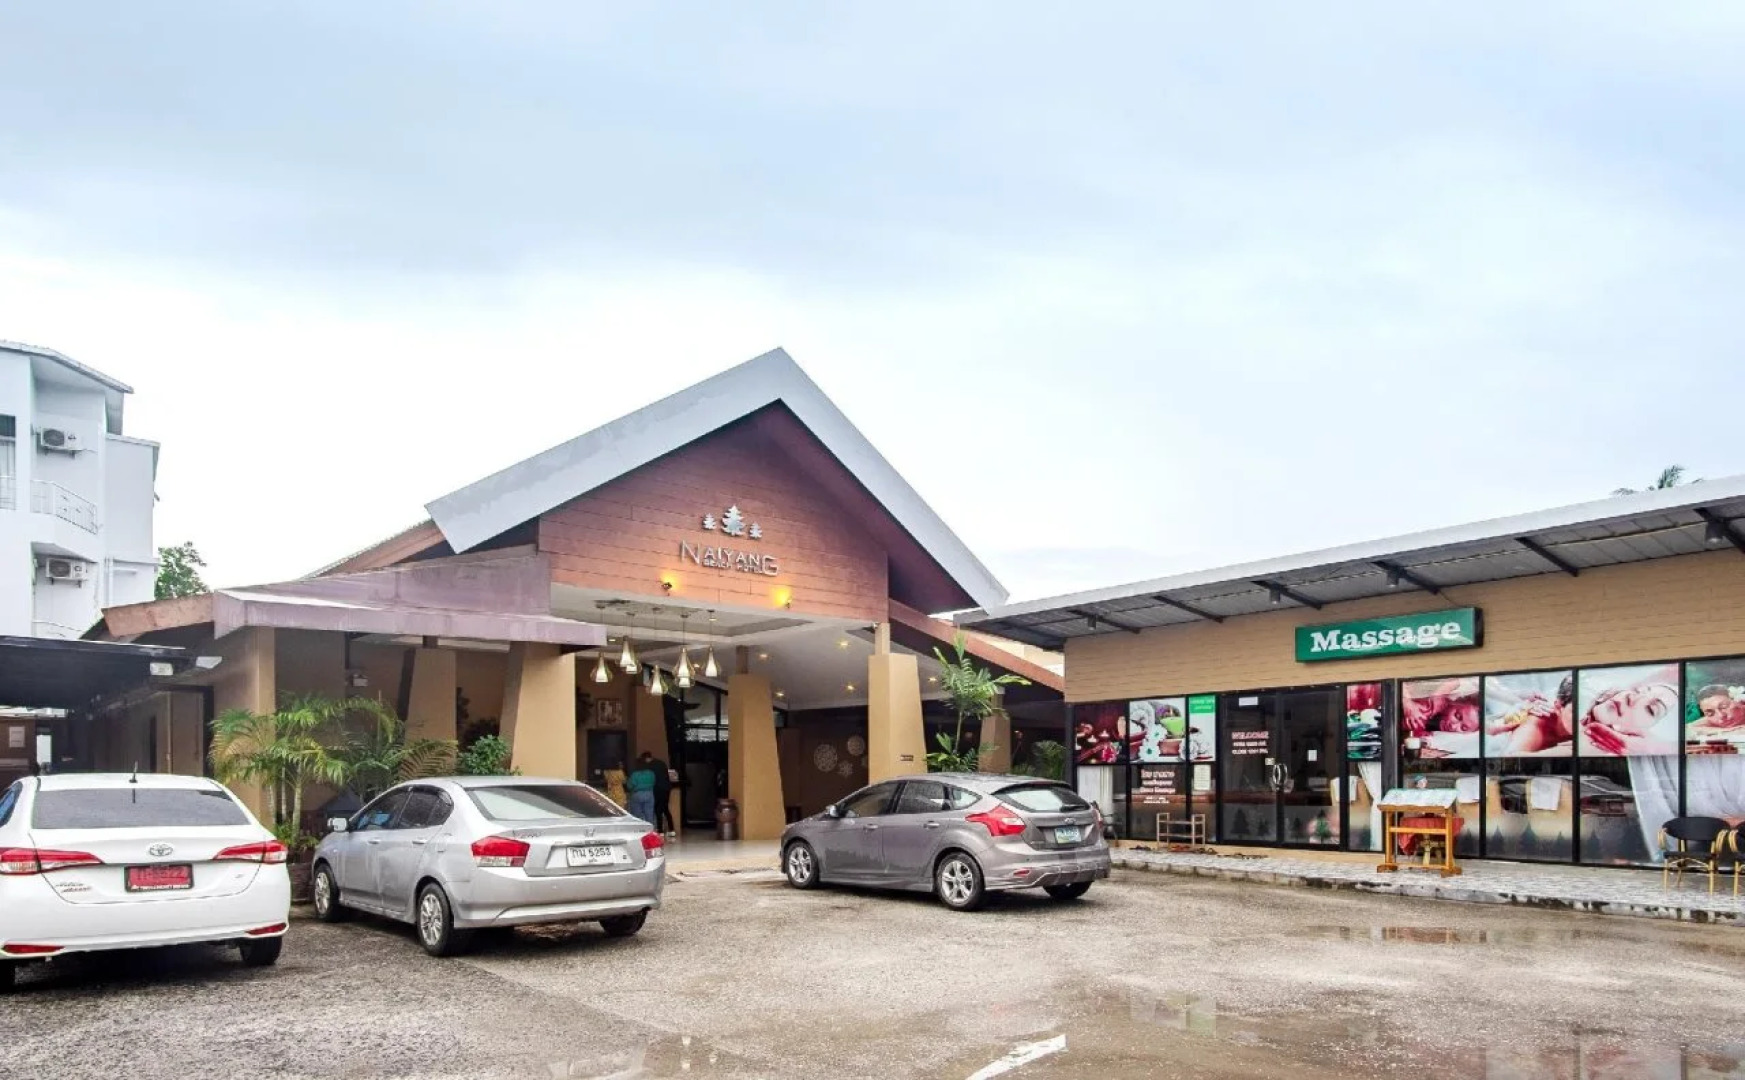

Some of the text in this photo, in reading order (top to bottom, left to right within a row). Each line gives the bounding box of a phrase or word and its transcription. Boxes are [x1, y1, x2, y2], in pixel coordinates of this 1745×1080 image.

[680, 539, 779, 577] NAIYANG
[703, 558, 733, 570] BEACH
[1310, 621, 1461, 653] Massage
[1231, 731, 1269, 740] WELCOME
